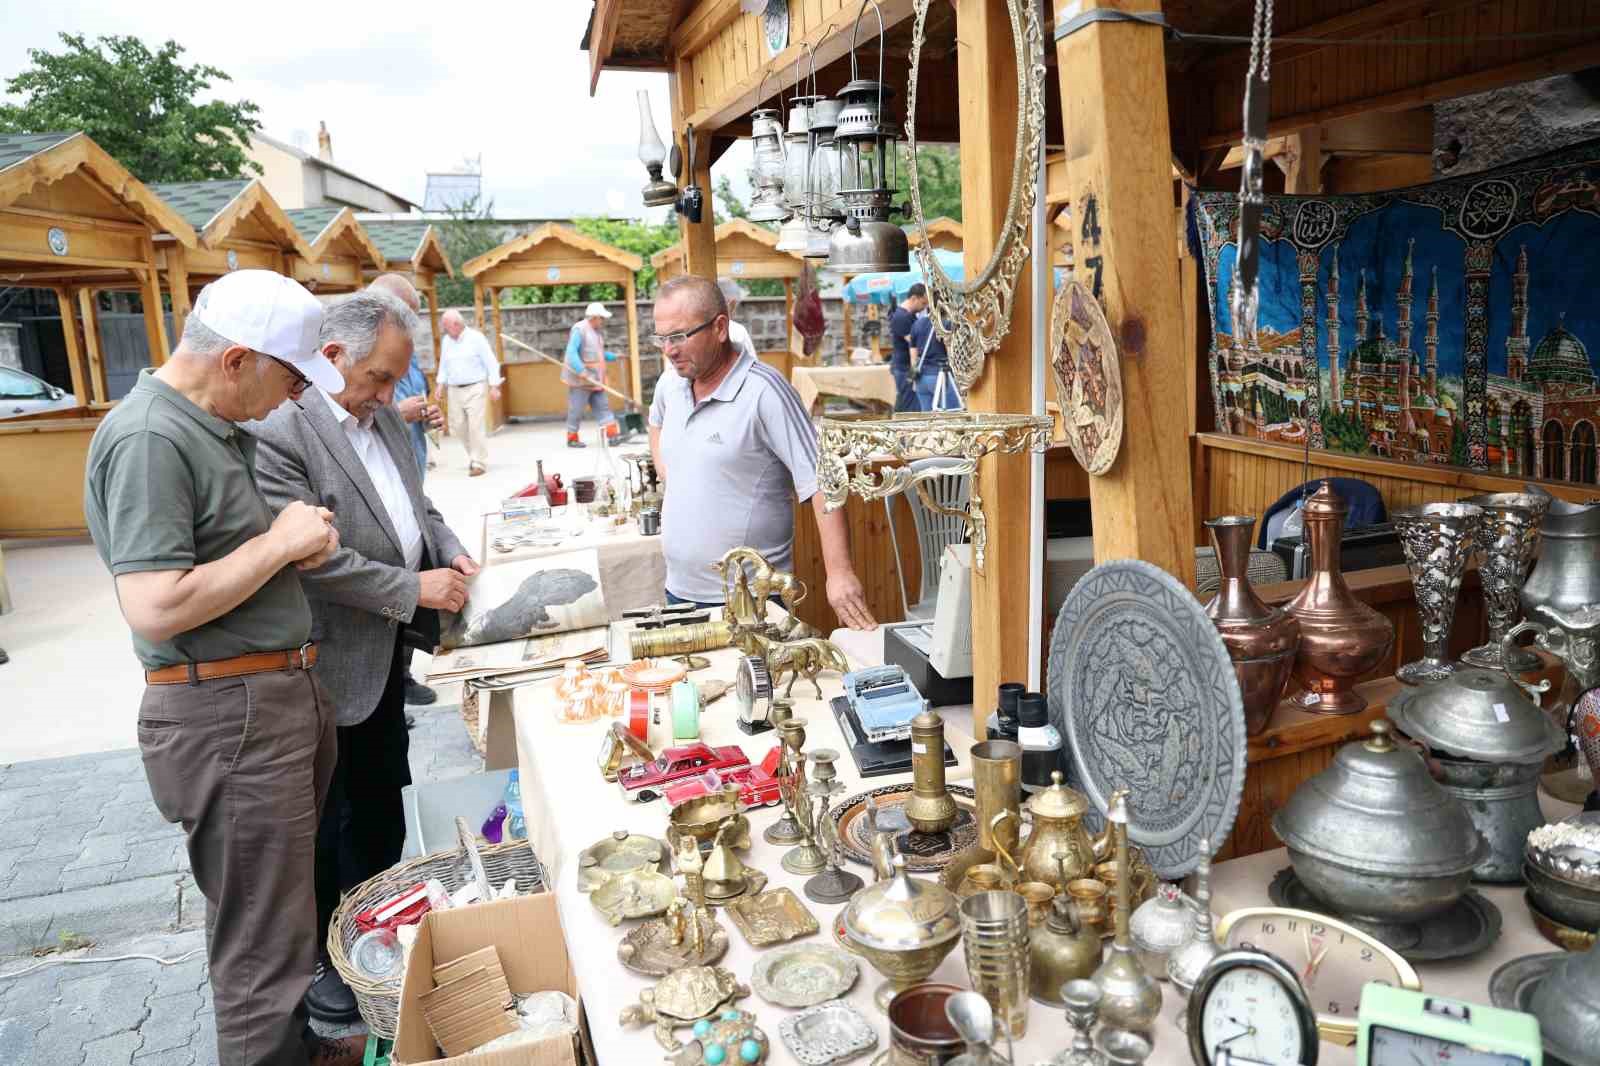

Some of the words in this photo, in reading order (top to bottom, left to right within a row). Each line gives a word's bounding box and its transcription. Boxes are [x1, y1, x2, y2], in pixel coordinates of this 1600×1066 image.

[1262, 922, 1276, 936] 10
[1288, 921, 1297, 932] 11
[1310, 924, 1326, 936] 12
[1361, 949, 1373, 962] 2
[1328, 1001, 1340, 1014] 5
